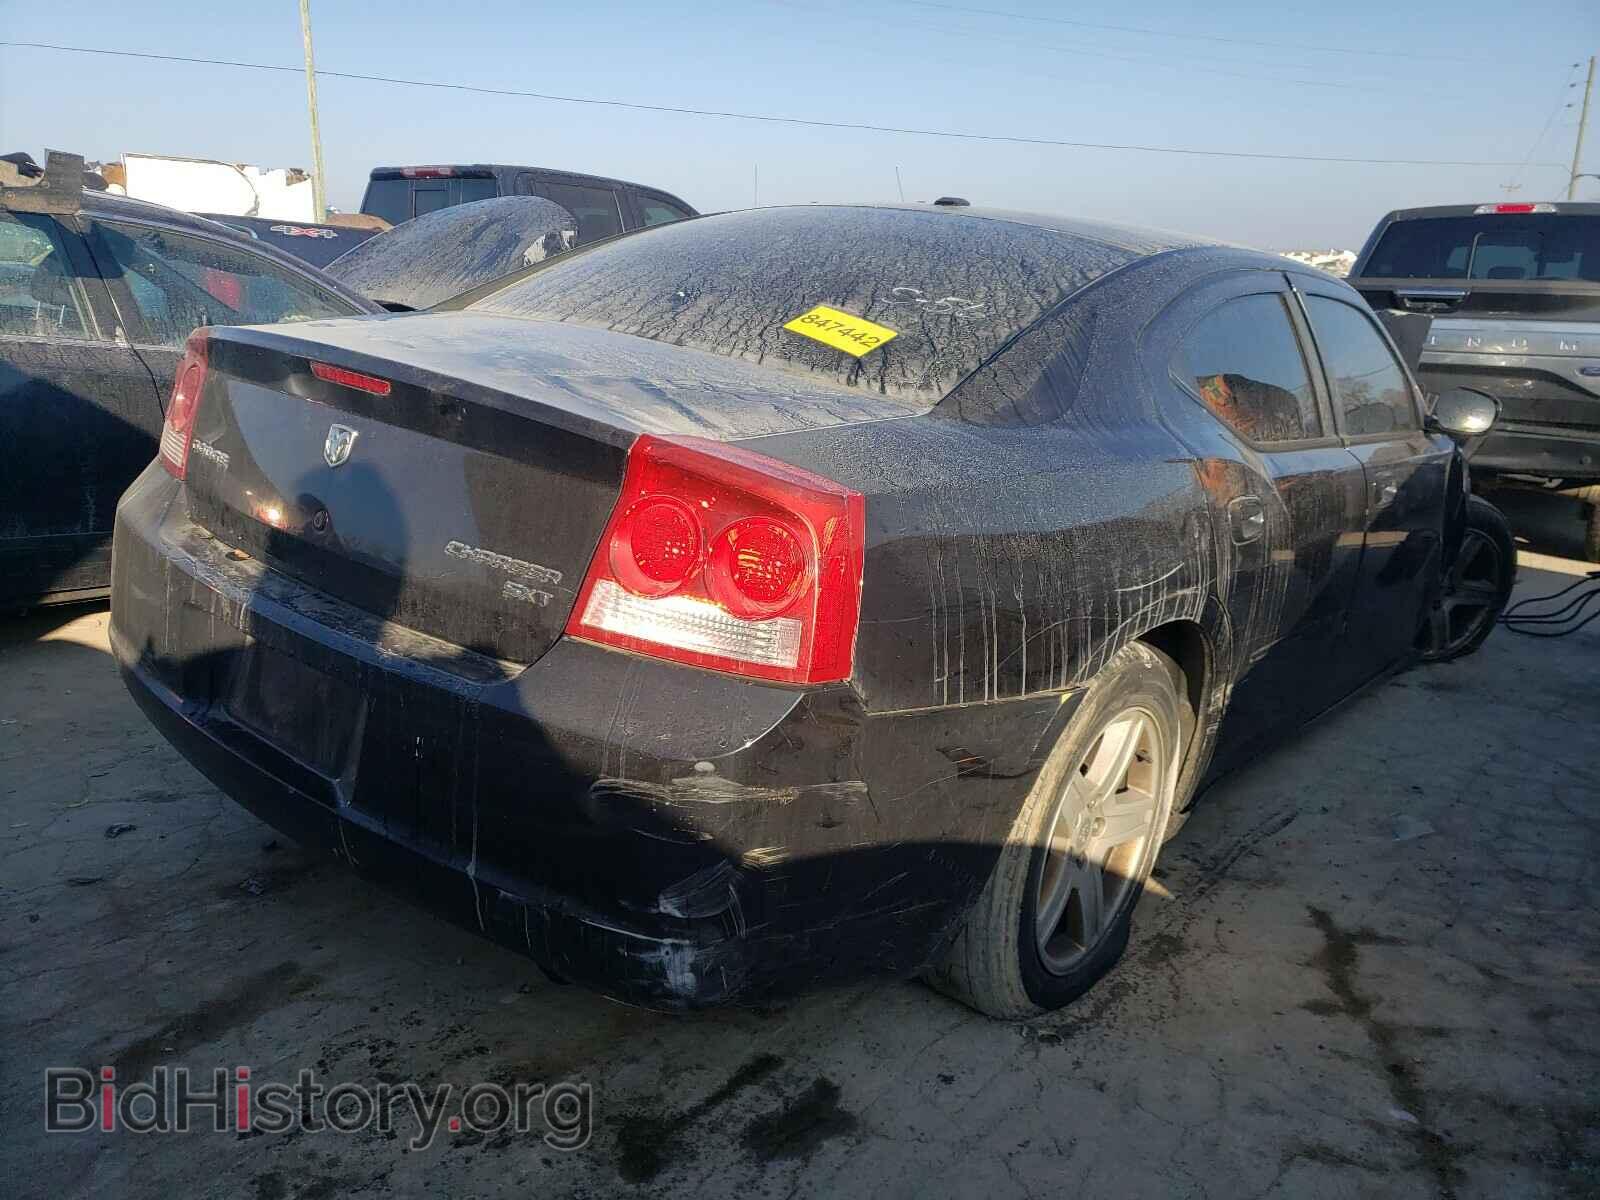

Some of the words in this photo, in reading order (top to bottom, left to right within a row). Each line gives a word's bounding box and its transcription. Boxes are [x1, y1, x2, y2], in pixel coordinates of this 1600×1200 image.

[800, 313, 881, 348] 847442
[444, 540, 563, 585] CHARGER
[502, 580, 554, 608] SXT
